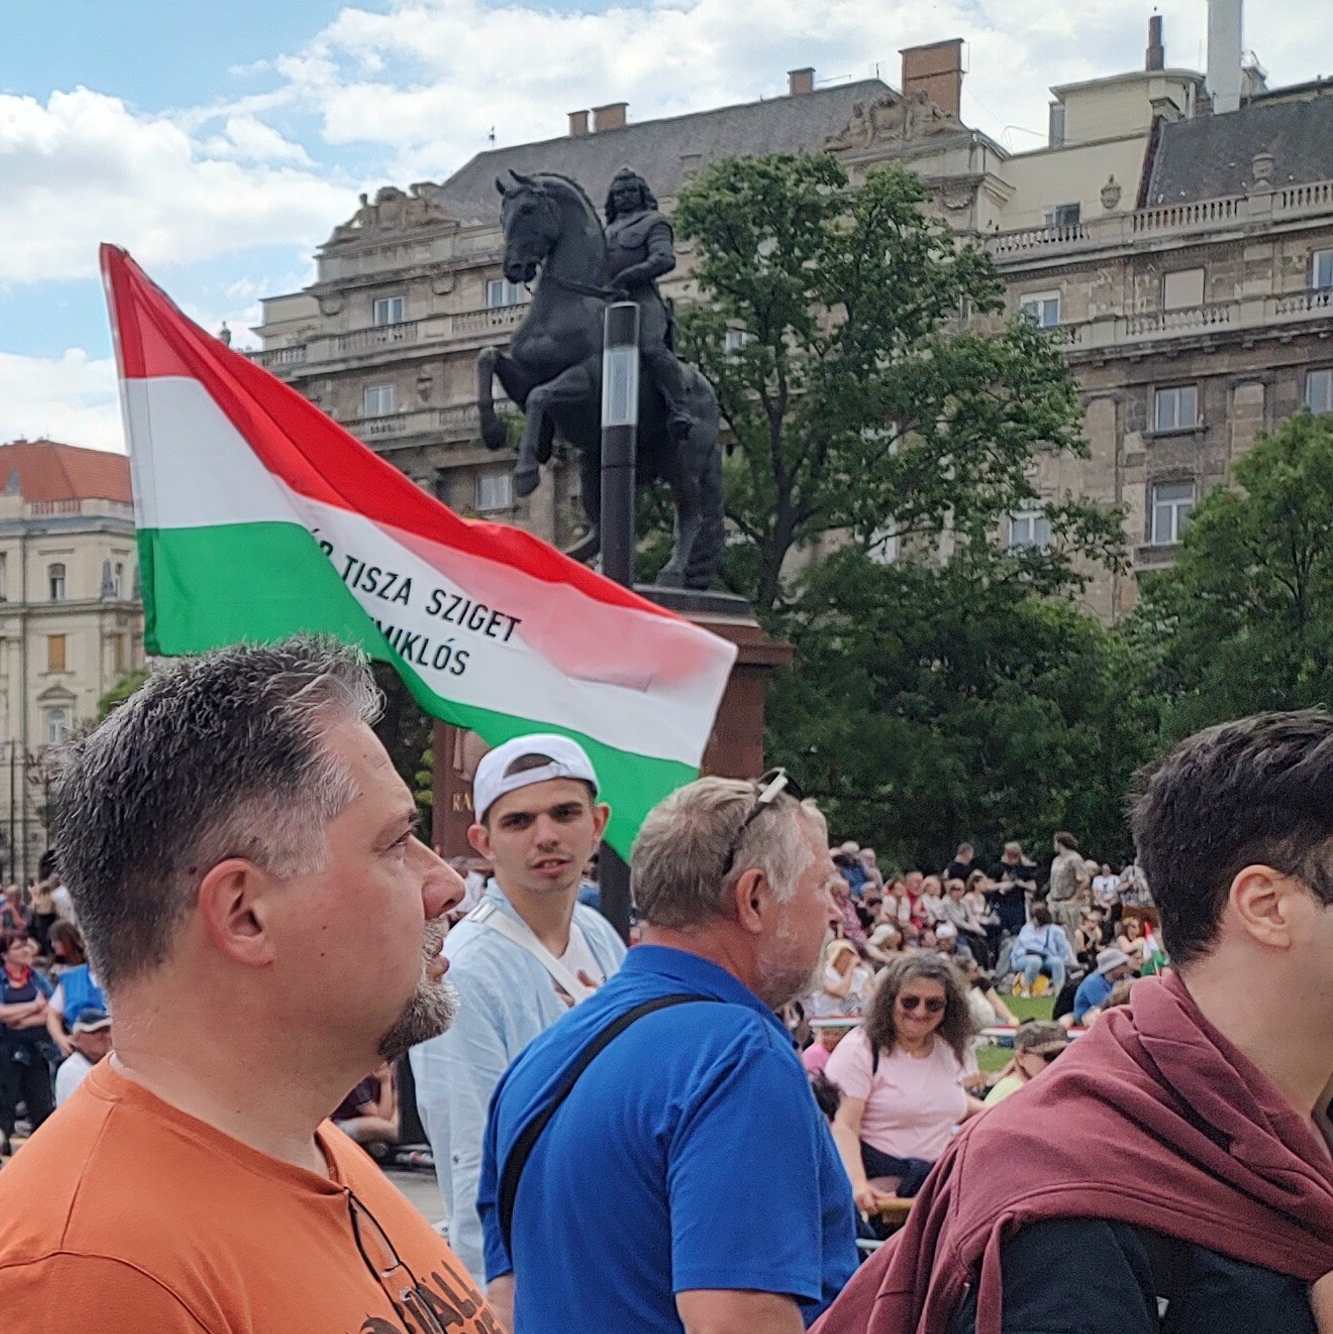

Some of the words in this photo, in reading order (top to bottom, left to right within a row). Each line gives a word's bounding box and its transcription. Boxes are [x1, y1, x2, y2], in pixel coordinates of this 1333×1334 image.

[342, 555, 412, 606] TISZA
[425, 588, 522, 642] SZIGET
[370, 617, 470, 676] MIKLÓS
